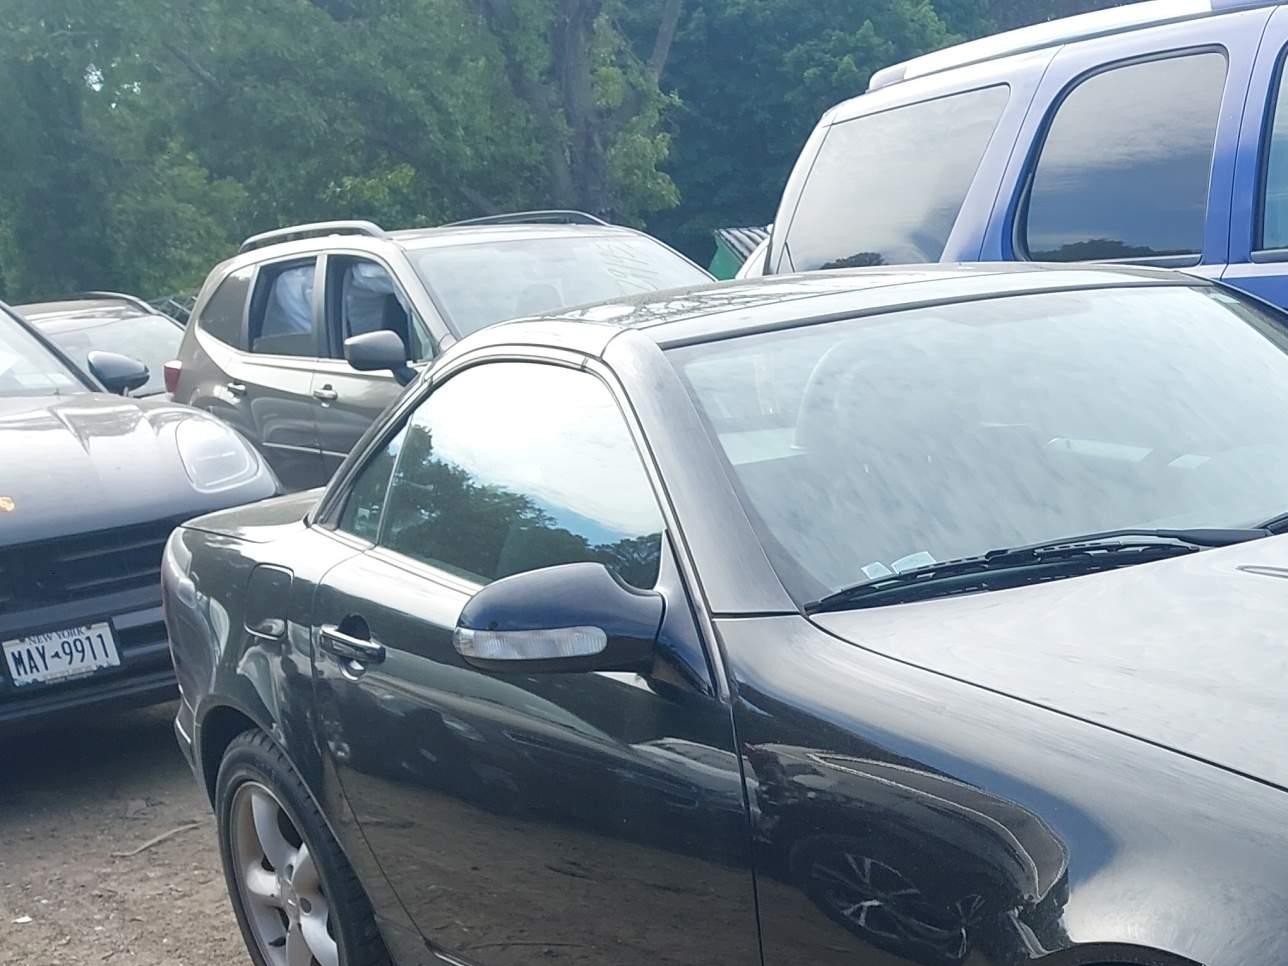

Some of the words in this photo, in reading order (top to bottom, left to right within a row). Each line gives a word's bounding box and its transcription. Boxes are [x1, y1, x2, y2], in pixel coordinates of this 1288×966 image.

[29, 632, 53, 646] NEW
[57, 627, 86, 640] YORK
[11, 645, 49, 677] MAY
[61, 633, 110, 666] 9911
